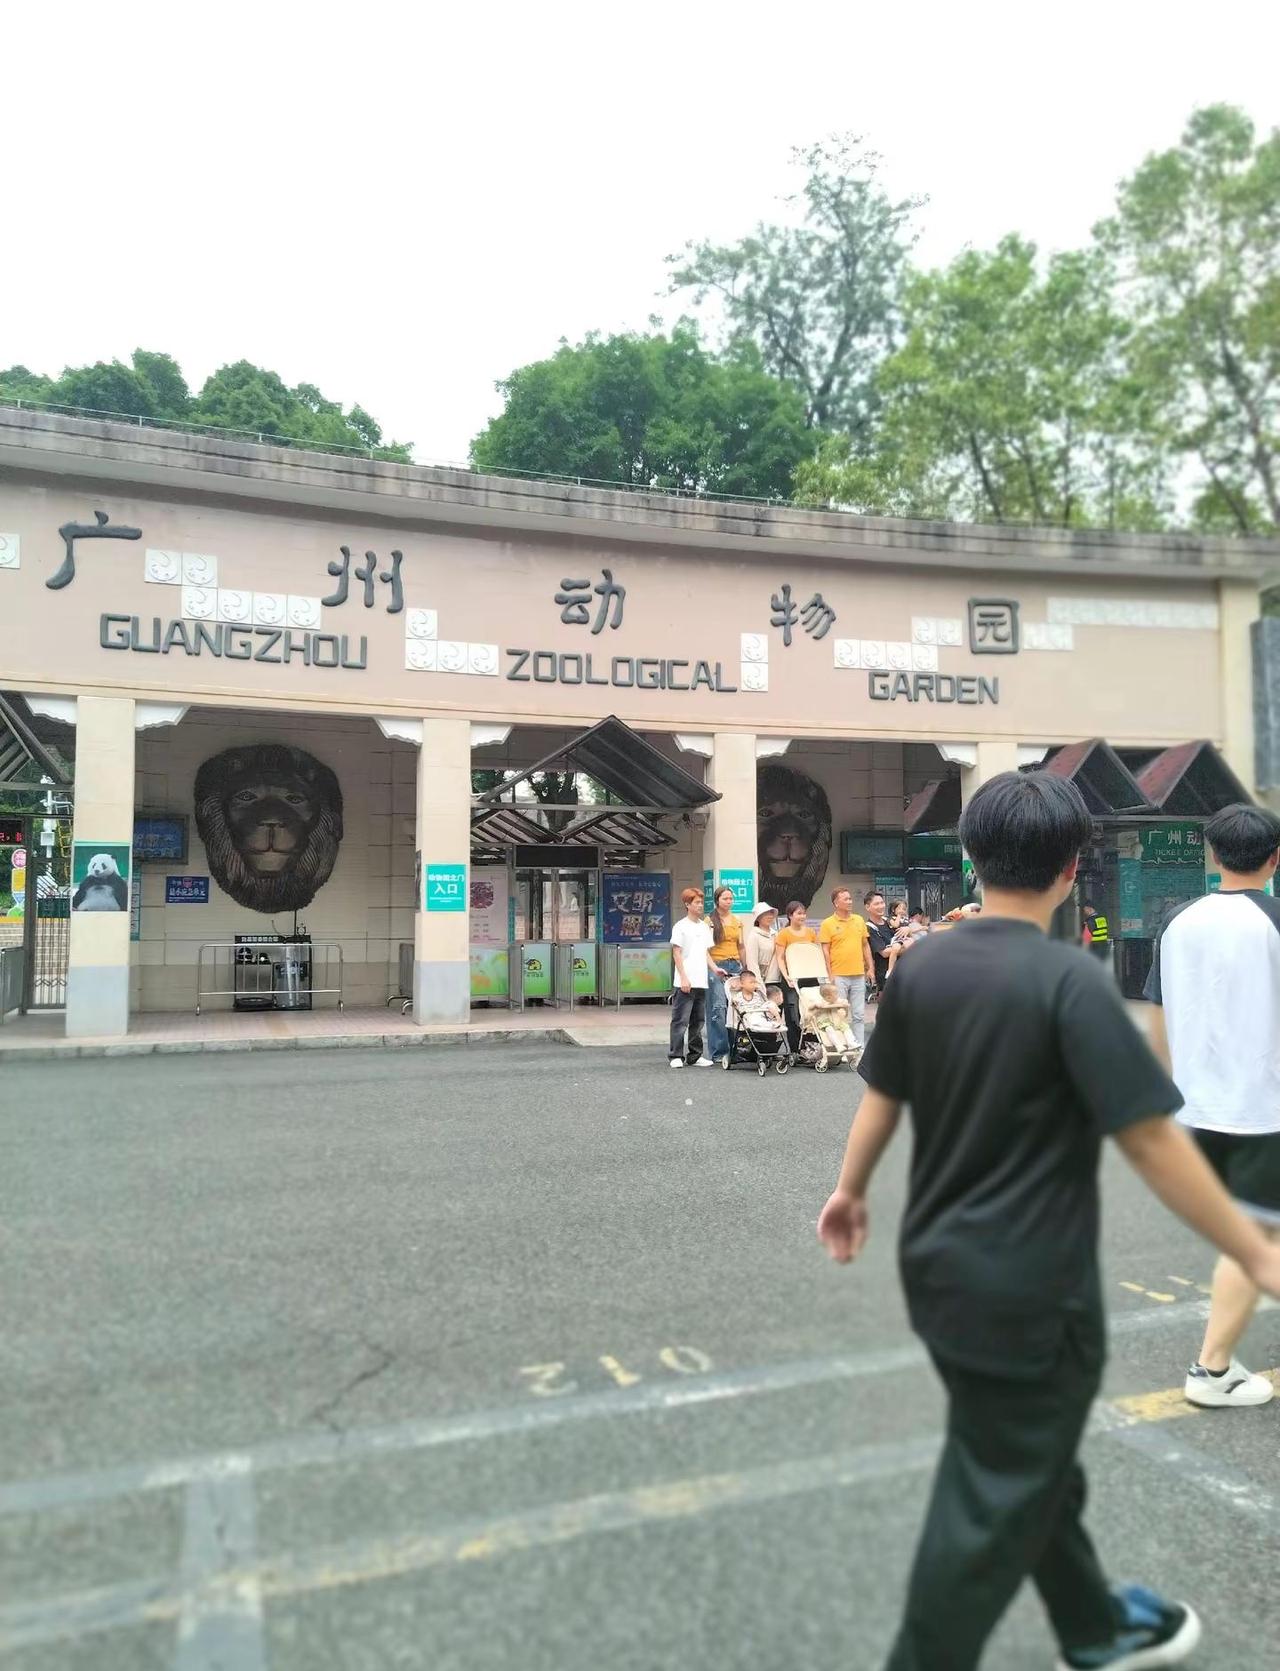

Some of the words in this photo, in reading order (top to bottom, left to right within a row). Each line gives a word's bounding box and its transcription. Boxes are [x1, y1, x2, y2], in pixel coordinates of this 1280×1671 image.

[45, 510, 1020, 656] 广州动物园
[99, 613, 369, 670] GUANGZHOU
[506, 648, 738, 694] ZOOLOGICAL
[868, 672, 1000, 706] GARDEN
[434, 882, 458, 895] 入口
